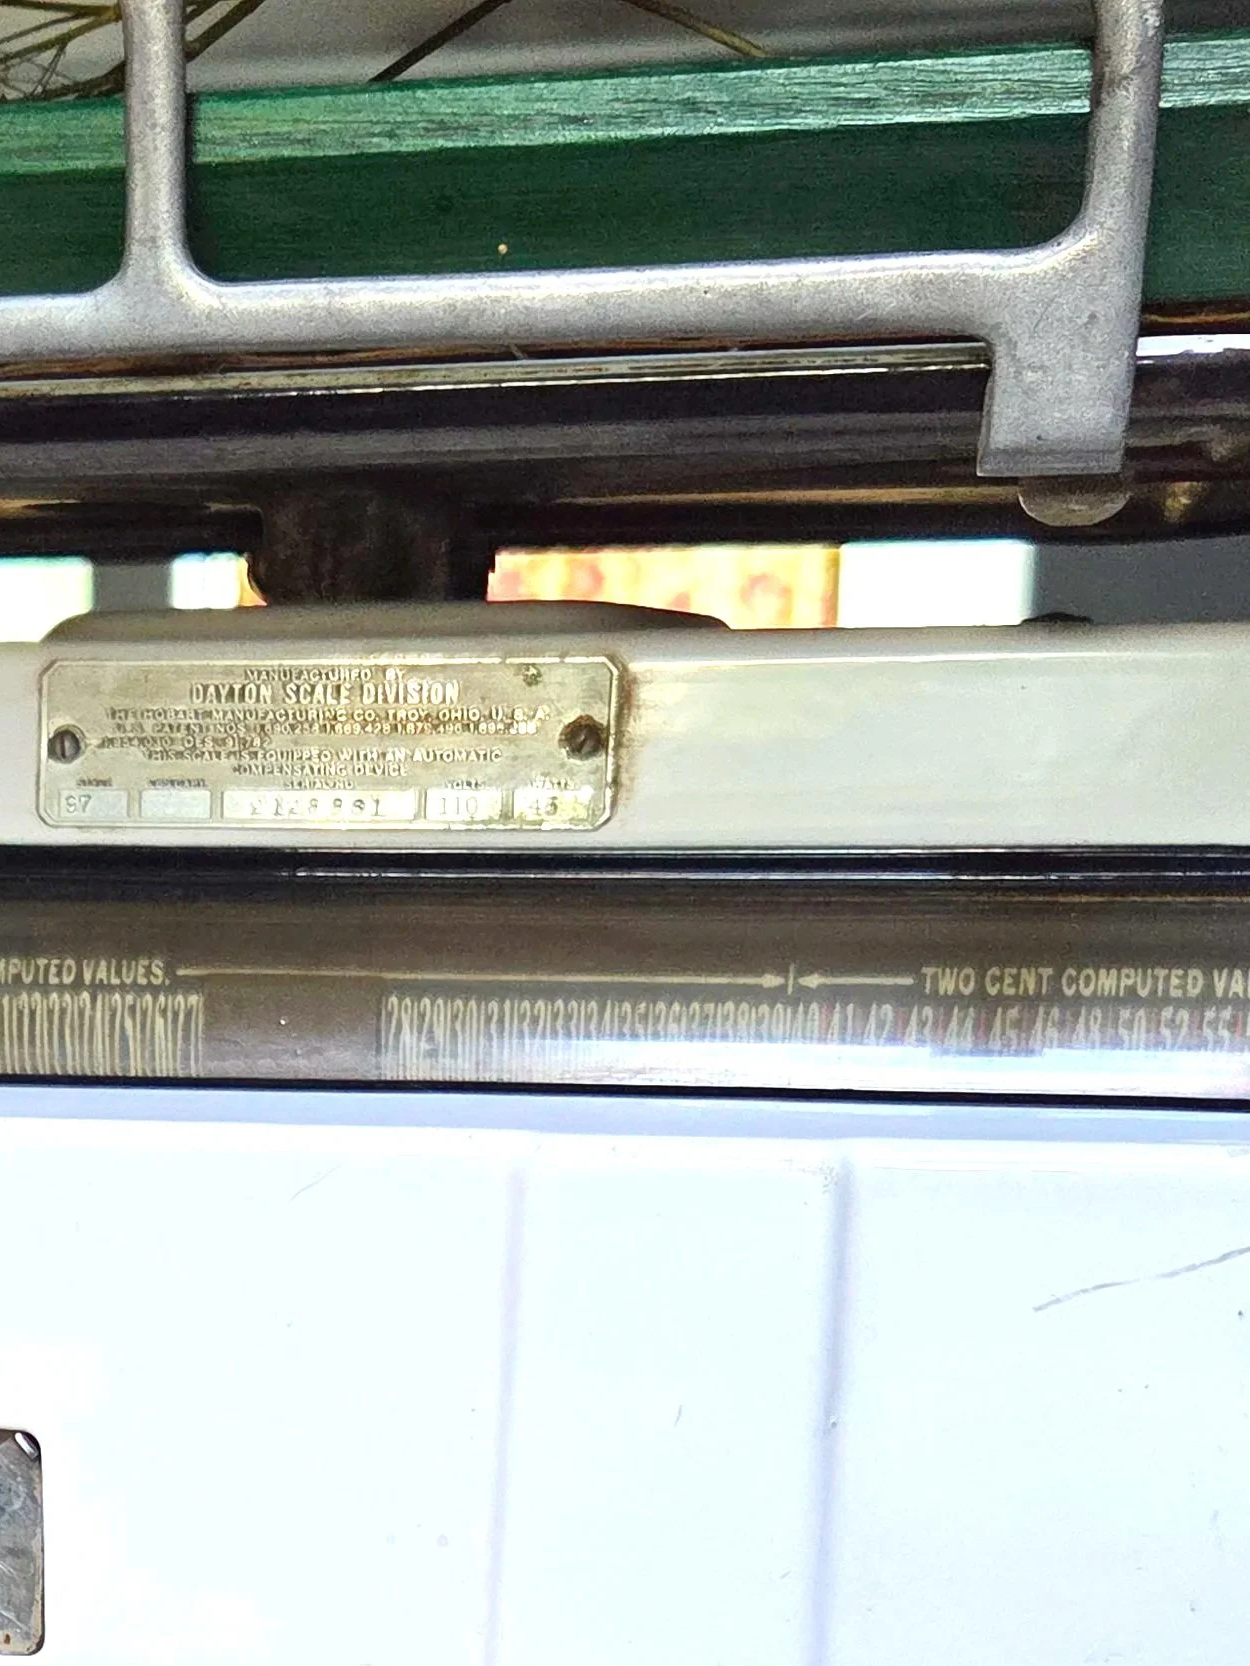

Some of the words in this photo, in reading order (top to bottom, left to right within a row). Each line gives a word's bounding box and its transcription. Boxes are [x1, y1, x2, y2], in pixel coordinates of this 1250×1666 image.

[245, 667, 371, 681] MANUFACTURED
[386, 667, 406, 681] BY
[191, 683, 271, 704] DAYTON
[285, 683, 350, 704] SCALE
[362, 680, 459, 705] DIVISION
[211, 708, 348, 721] MANUFACTURING
[142, 749, 176, 761] THIS
[183, 750, 228, 761] SCALE
[235, 750, 250, 761] IS
[257, 749, 331, 761] EQUIPPED
[338, 748, 378, 762] WITH
[386, 748, 406, 762] AN
[412, 748, 502, 762] AUTOMATIC
[232, 763, 347, 776] COMPENSATING
[354, 763, 407, 776] DEVICE
[921, 966, 975, 996] TWO
[985, 966, 1053, 997] CENT
[1061, 967, 1204, 998] COMPUTED
